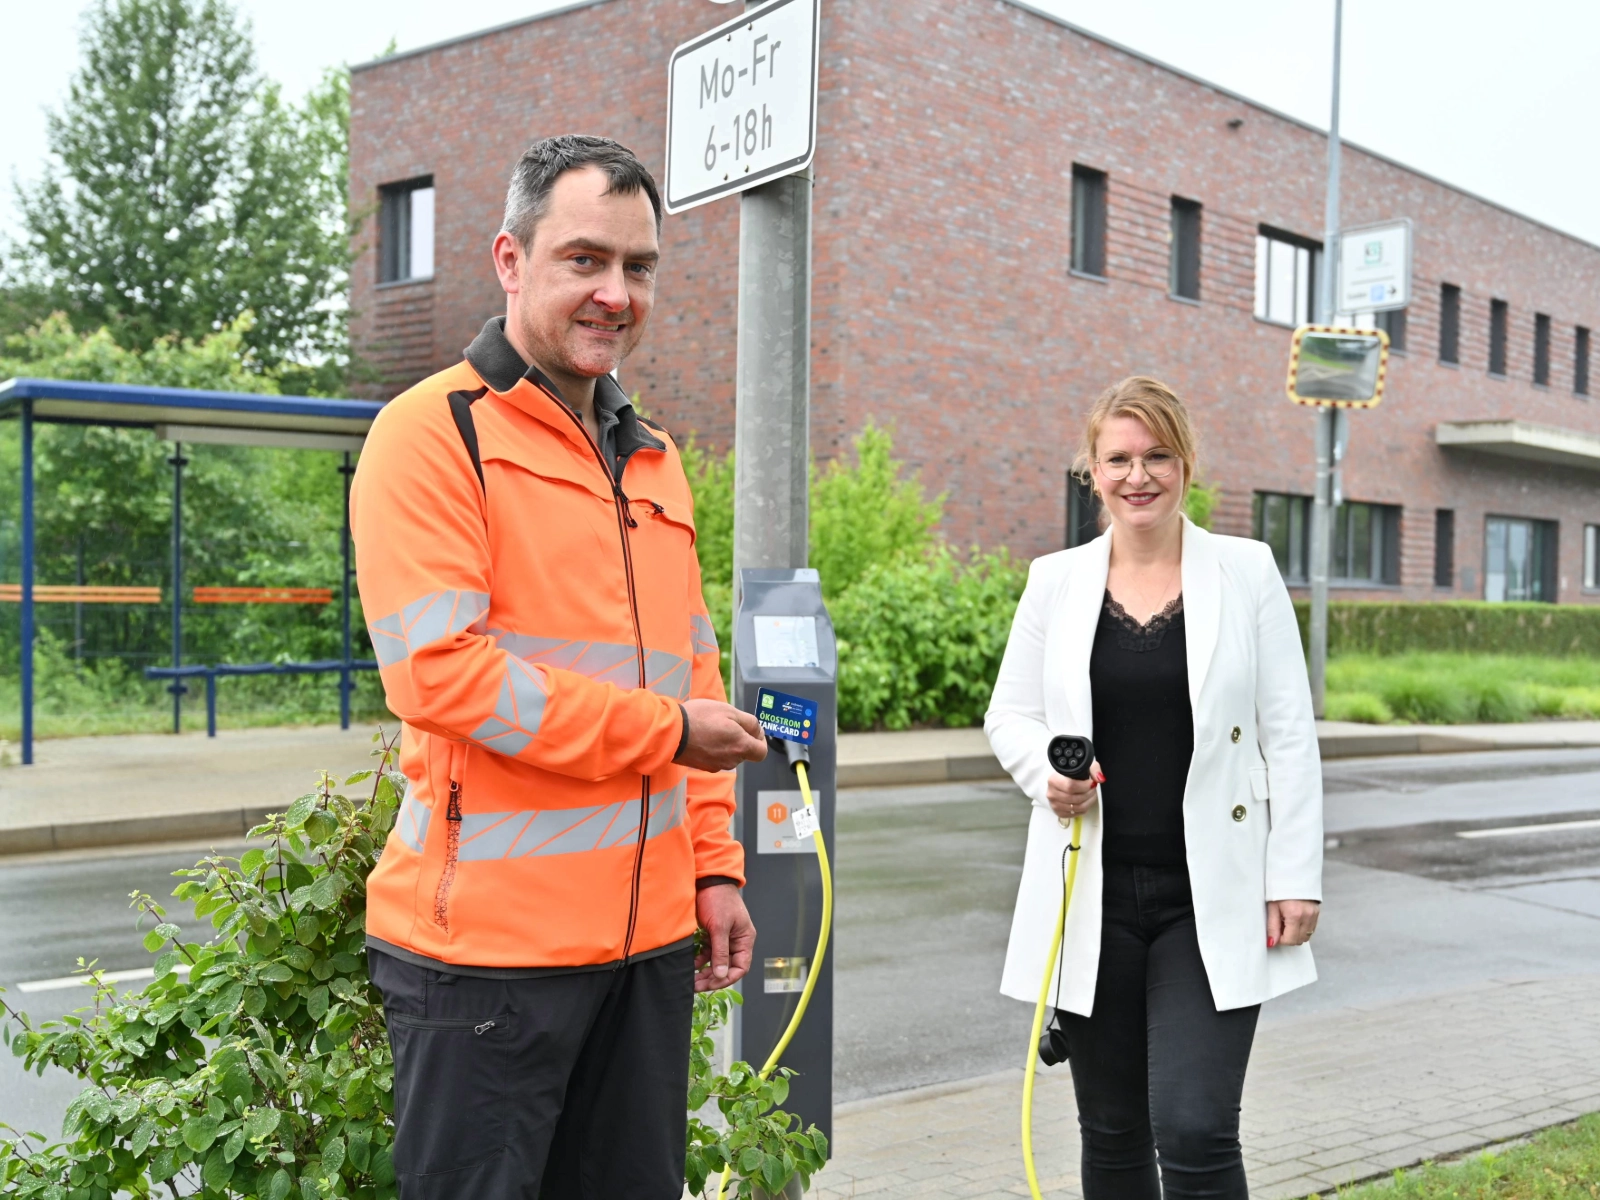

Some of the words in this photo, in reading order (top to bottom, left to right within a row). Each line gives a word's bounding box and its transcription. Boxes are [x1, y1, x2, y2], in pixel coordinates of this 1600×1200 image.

[699, 33, 782, 110] Mo-Fr
[704, 103, 773, 171] 6-18h
[758, 720, 800, 737] TANK-CARD
[759, 710, 801, 729] ÖKOSTROM
